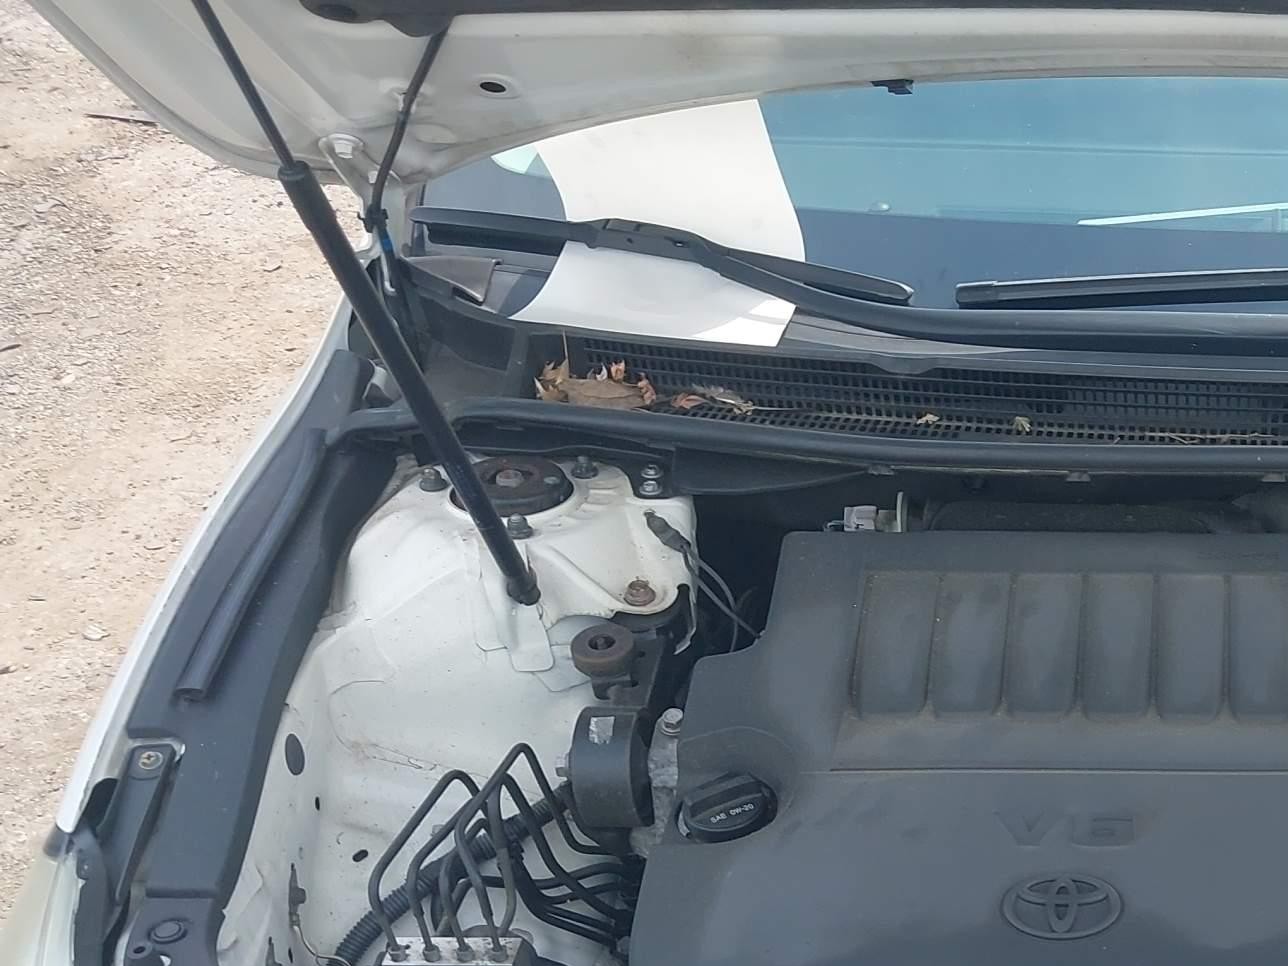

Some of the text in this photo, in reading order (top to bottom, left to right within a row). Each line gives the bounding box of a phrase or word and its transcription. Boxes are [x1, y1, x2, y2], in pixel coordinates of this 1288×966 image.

[710, 803, 754, 823] SAE 0W-20
[995, 811, 1136, 848] V6
